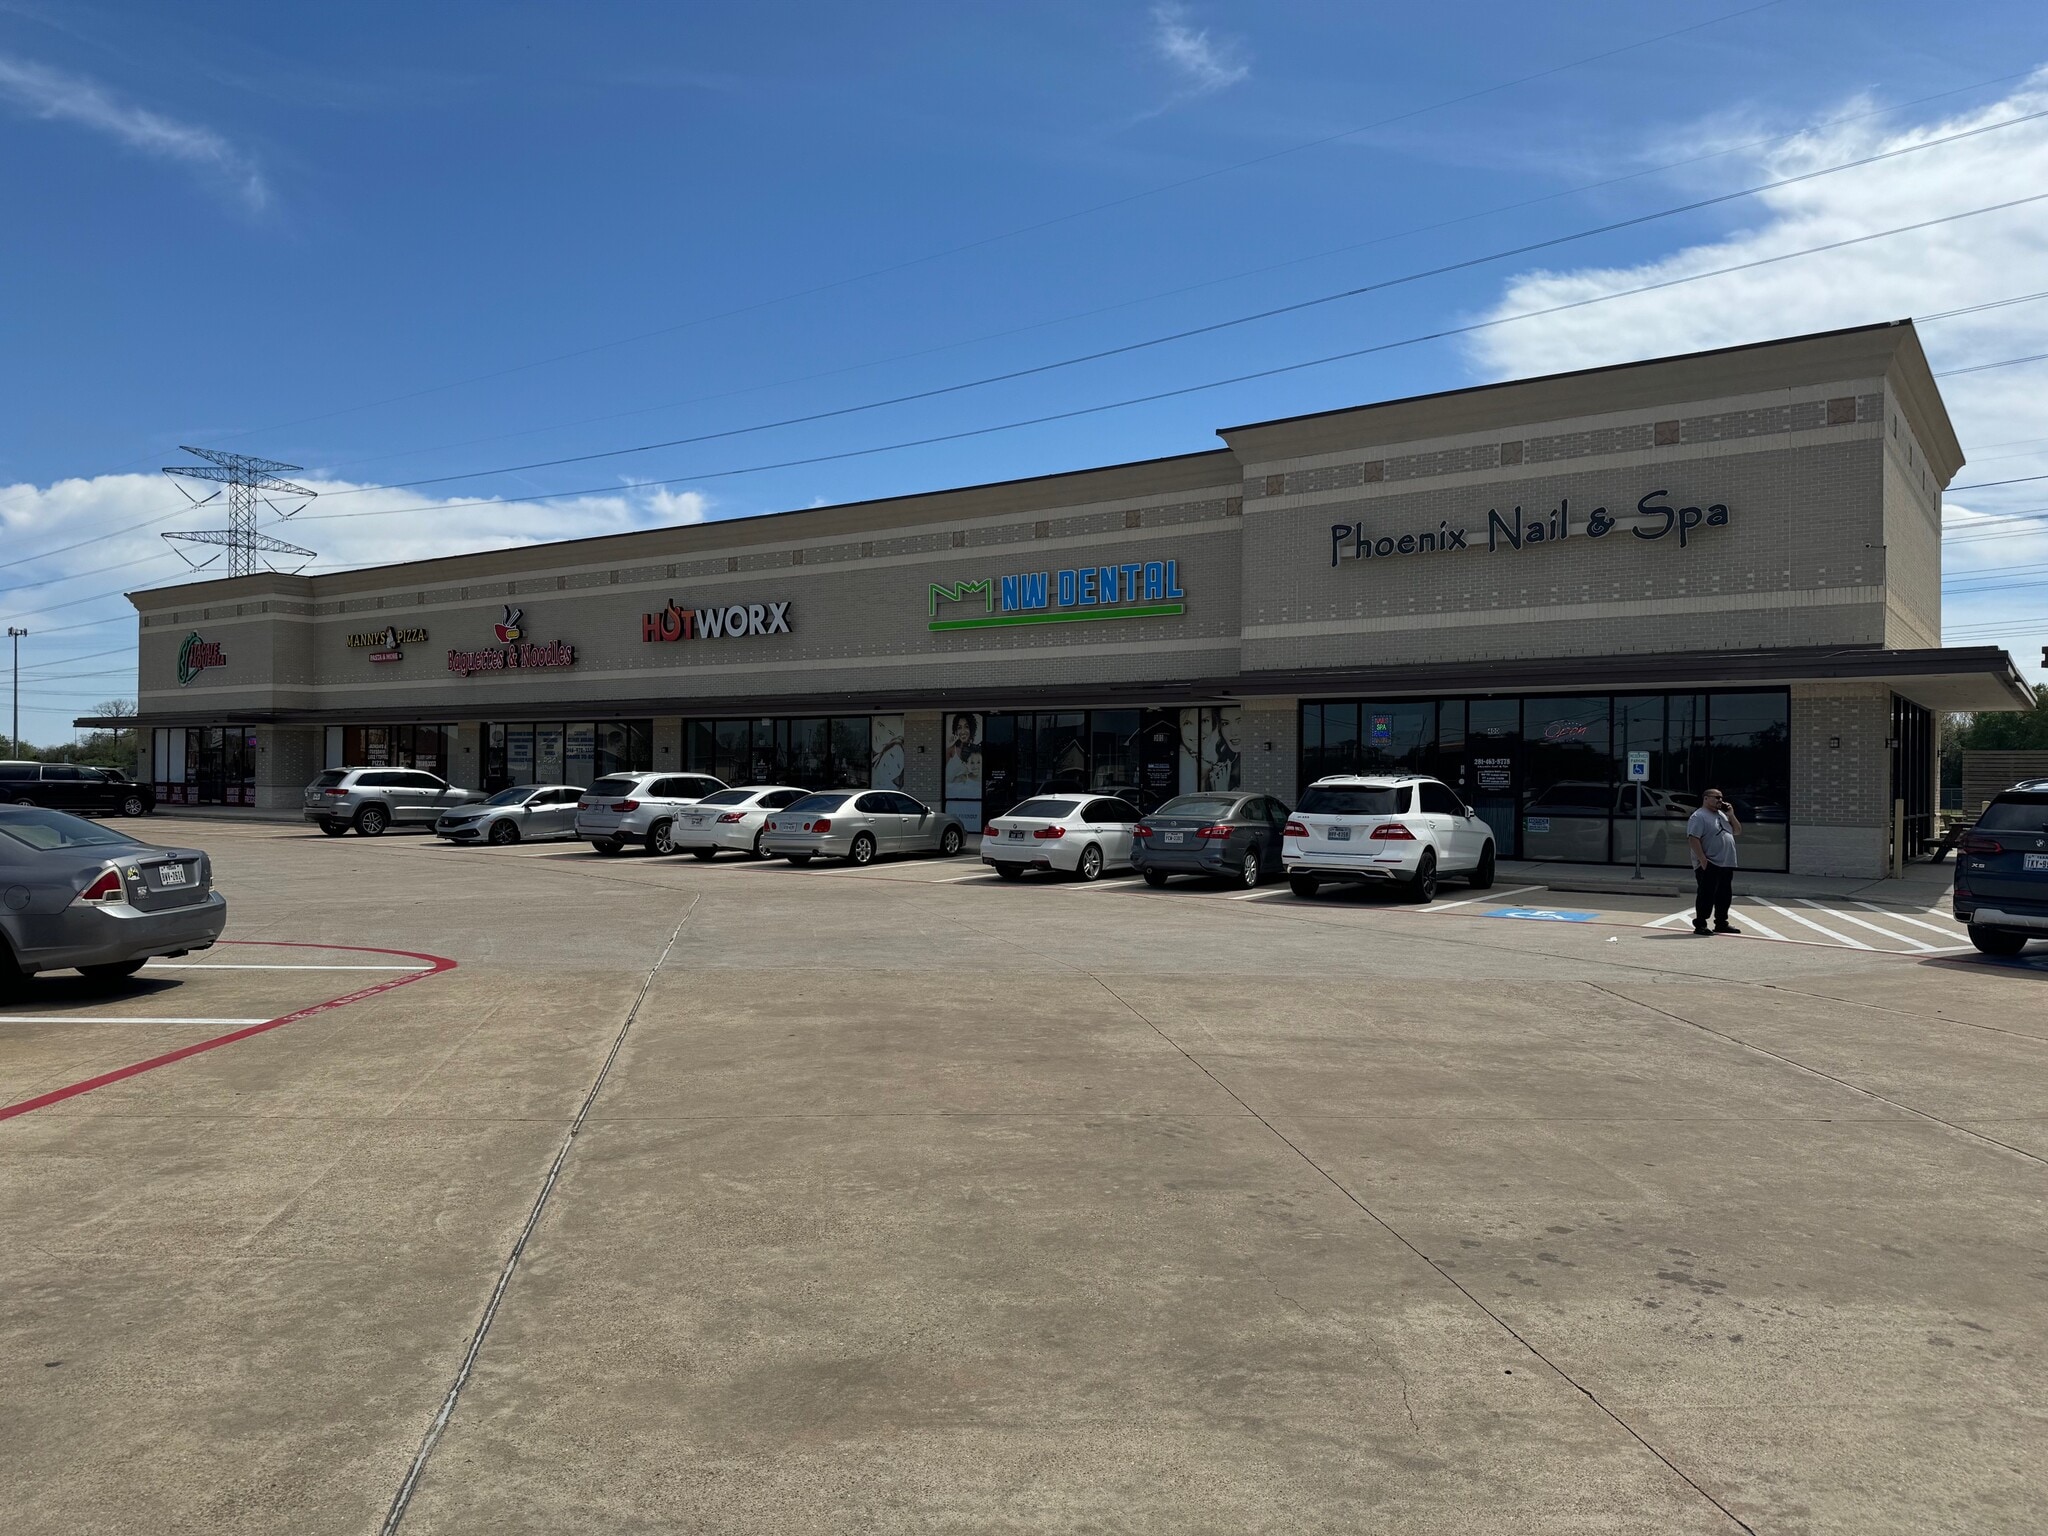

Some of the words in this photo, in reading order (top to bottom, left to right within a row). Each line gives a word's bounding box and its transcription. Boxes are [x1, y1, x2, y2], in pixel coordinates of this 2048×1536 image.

[1331, 520, 1468, 568] Phoenix
[1488, 498, 1568, 553] Nail
[1586, 507, 1615, 539] &
[1632, 490, 1730, 548] Spa
[1001, 573, 1049, 612] NW
[1057, 559, 1185, 607] DENTAL
[642, 598, 792, 642] HOTWORX
[397, 628, 425, 643] PIZZA
[188, 654, 226, 668] TAQUERIA
[447, 648, 505, 677] Baguettes
[508, 644, 519, 668] &
[521, 639, 573, 668] Noodles
[1376, 723, 1387, 731] SPA
[1545, 723, 1588, 739] Open
